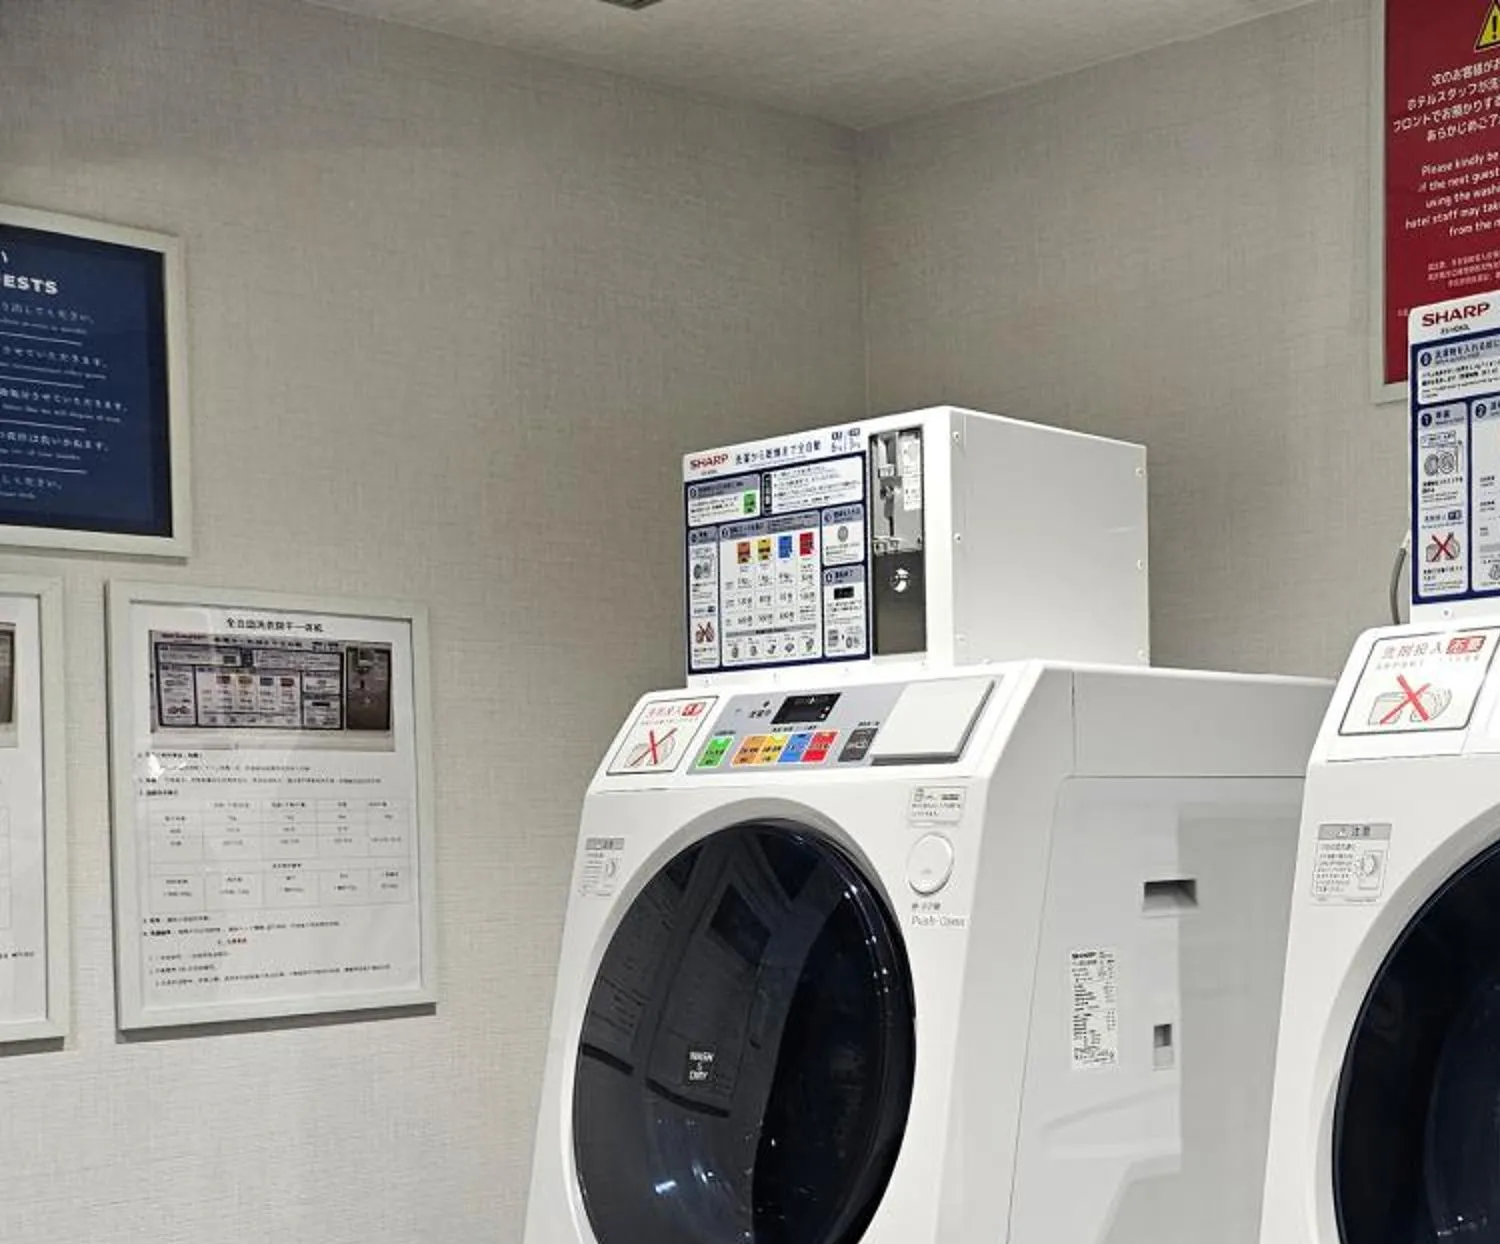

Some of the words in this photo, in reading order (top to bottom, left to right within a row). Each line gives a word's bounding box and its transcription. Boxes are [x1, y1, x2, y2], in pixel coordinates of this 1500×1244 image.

[1421, 162, 1452, 176] Please
[1455, 155, 1485, 169] kindly
[1486, 151, 1499, 162] be
[1429, 180, 1446, 191] the
[1448, 175, 1470, 188] next
[1471, 167, 1500, 184] guest
[1425, 195, 1451, 209] using
[1454, 190, 1471, 202] the
[1404, 216, 1430, 230] hotel
[1432, 208, 1458, 224] staff
[1460, 206, 1481, 219] may
[1449, 223, 1473, 237] from
[1475, 218, 1493, 231] the
[1422, 303, 1490, 327] SHARP
[689, 453, 729, 470] SHARP
